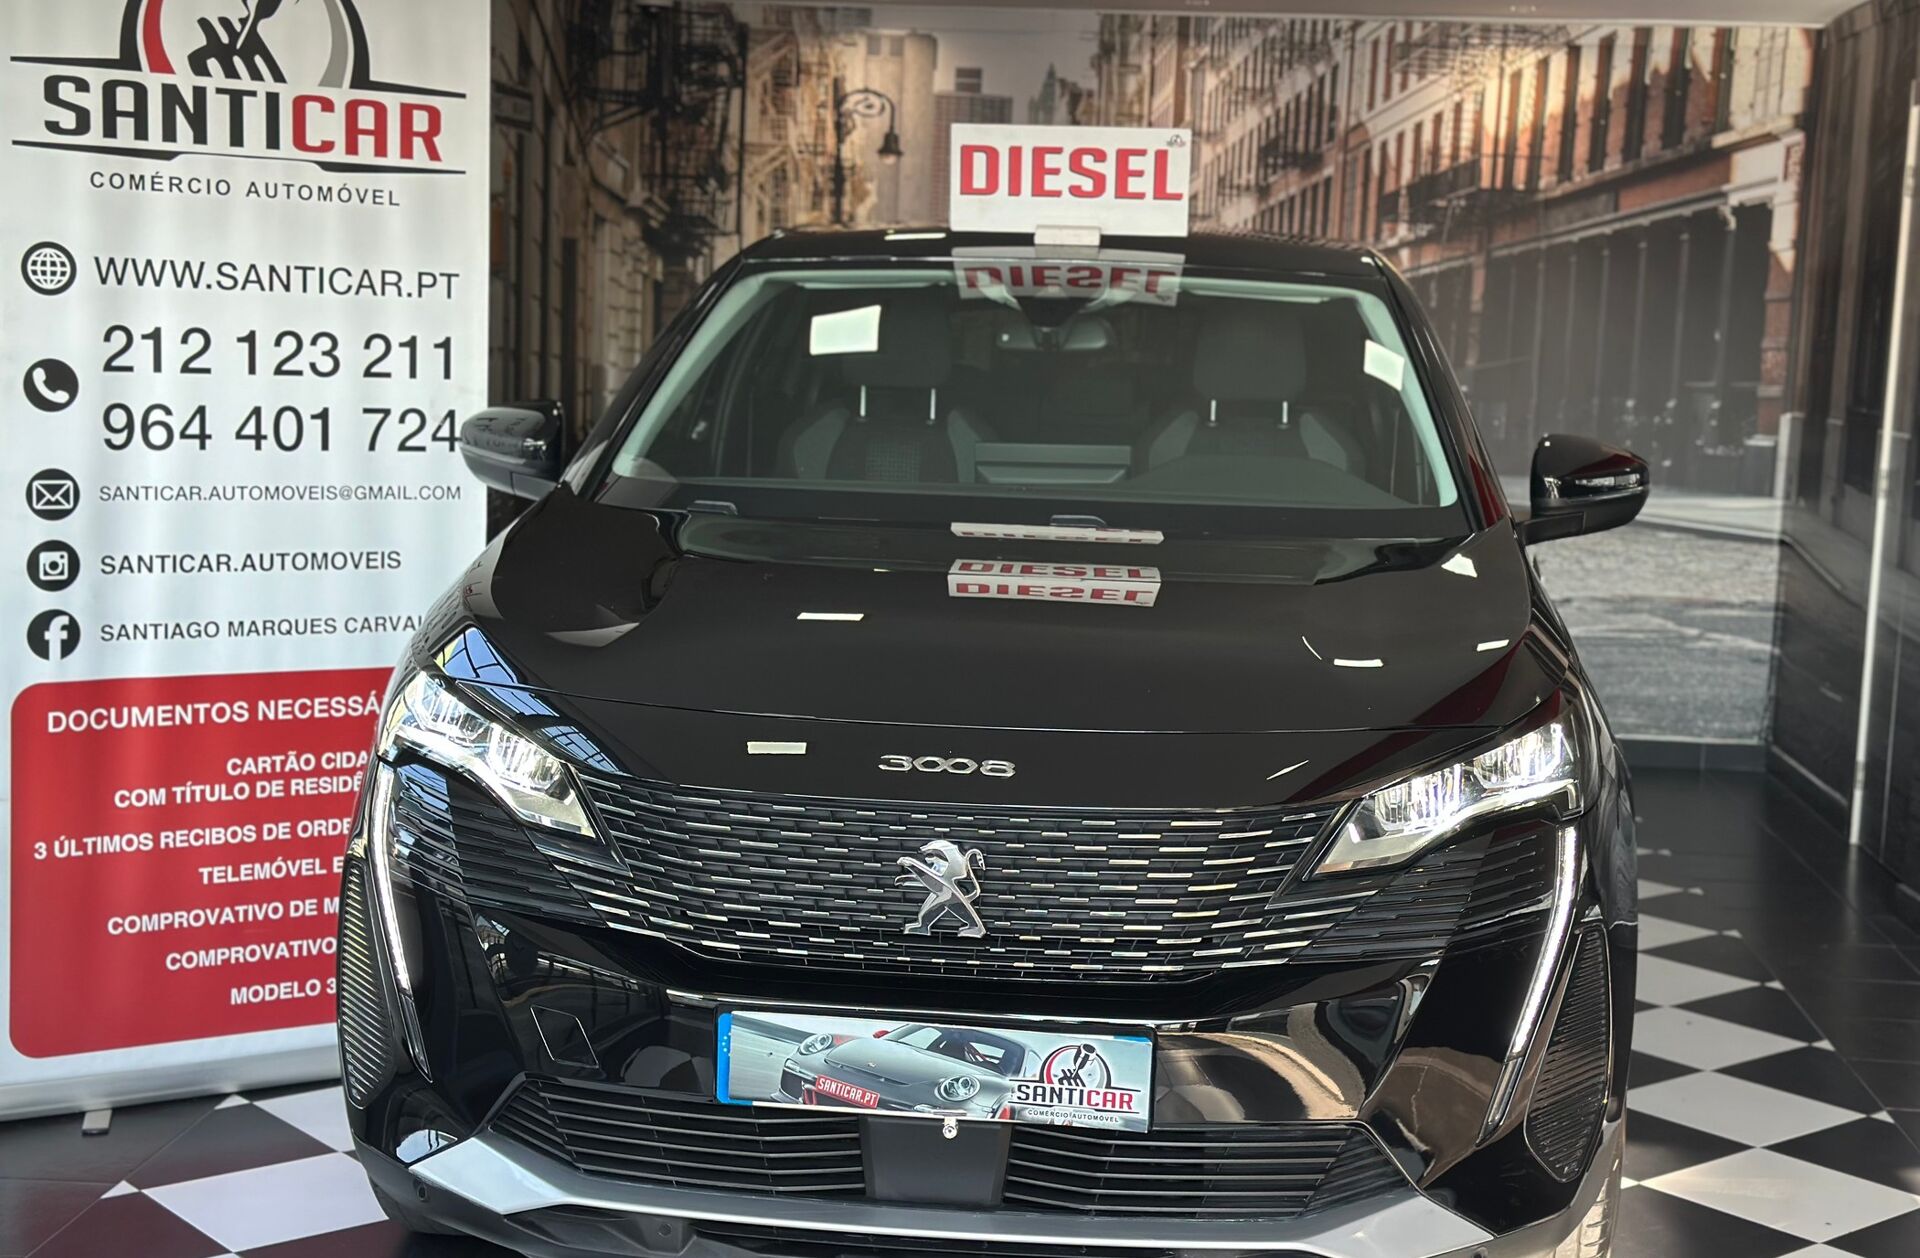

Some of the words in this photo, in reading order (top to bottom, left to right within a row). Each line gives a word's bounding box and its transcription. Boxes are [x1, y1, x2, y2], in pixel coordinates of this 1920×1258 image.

[42, 74, 443, 163] SANTICAR
[960, 145, 1183, 200] DIESEL
[91, 172, 230, 195] COMÉRCIO
[246, 182, 399, 206] AUTOMÓVEL
[94, 257, 459, 299] WWW.SANTICAR.PT
[103, 325, 211, 374] 212
[237, 330, 340, 377] 123
[363, 334, 451, 379] 211
[103, 403, 212, 450] 964
[235, 406, 329, 451] 401
[362, 407, 463, 452] 724
[100, 486, 460, 501] SANTICAR.AUTOMOVEIS@GMAIL.COM
[101, 551, 401, 574] SANTICAR.AUTOMOVEIS
[101, 621, 219, 641] SANTIAGO
[229, 618, 336, 636] MARQUES
[48, 701, 249, 733] DOCUMENTOS
[227, 751, 315, 776] CARTÃO
[878, 754, 1016, 778] 3008
[114, 788, 166, 808] COM
[172, 781, 250, 804] TÍTULO
[256, 780, 284, 798] DE
[34, 842, 47, 859] 3
[54, 833, 153, 858] ÚLTIMOS
[160, 825, 256, 849] RECIBOS
[263, 822, 291, 840] DE
[198, 857, 327, 884] TELEMÓVEL
[108, 902, 283, 935] COMPROVATIVO
[290, 899, 317, 917] DE
[166, 937, 337, 970] COMPROVATIVO
[231, 979, 321, 1005] MODELO
[817, 1077, 878, 1107] SANTICAR.PT
[1016, 1083, 1134, 1111] SANTICAR
